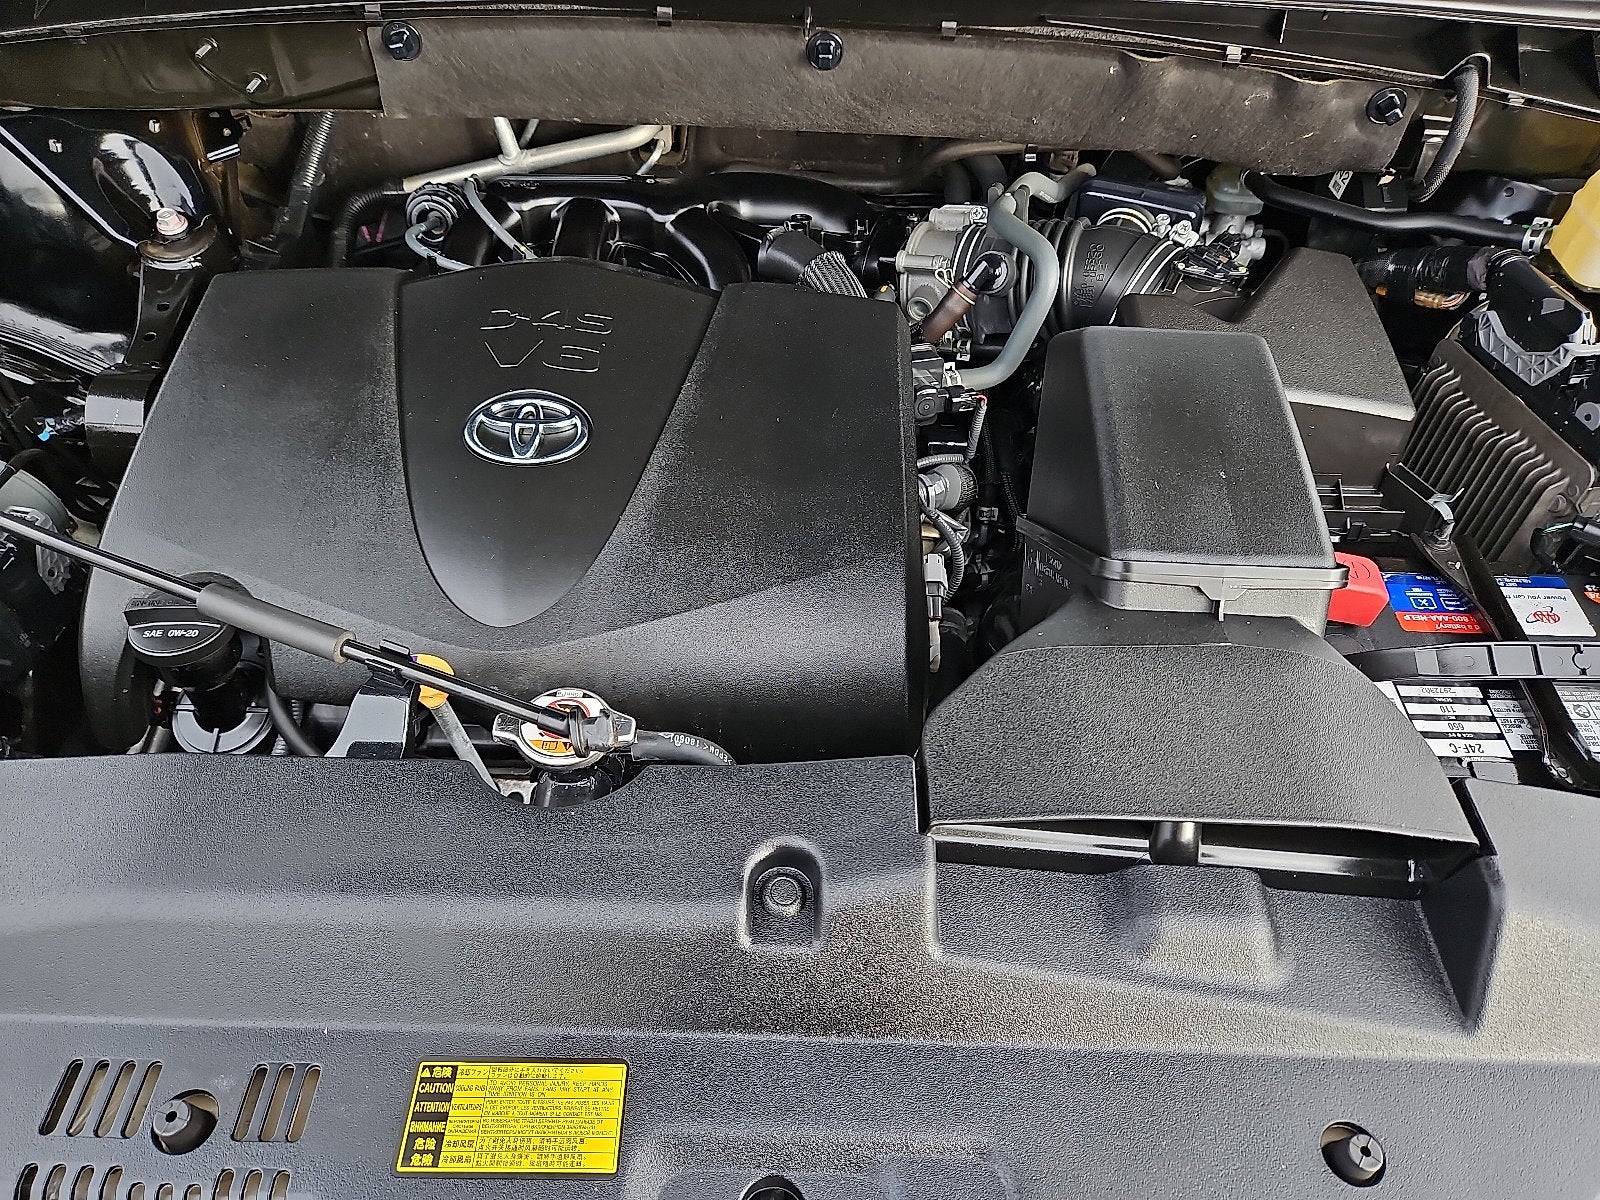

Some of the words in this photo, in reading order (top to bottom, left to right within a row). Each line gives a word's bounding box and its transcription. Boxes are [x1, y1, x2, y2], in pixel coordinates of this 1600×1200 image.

[484, 338, 602, 373] V6
[1435, 622, 1466, 631] battery?
[142, 630, 164, 638] SAE
[167, 629, 199, 638] 0W-20
[1439, 705, 1457, 714] 110
[1447, 722, 1465, 731] 650
[1448, 742, 1485, 754] 24F-C
[418, 1082, 455, 1094] CAUTION
[413, 1101, 451, 1113] ATTENTION
